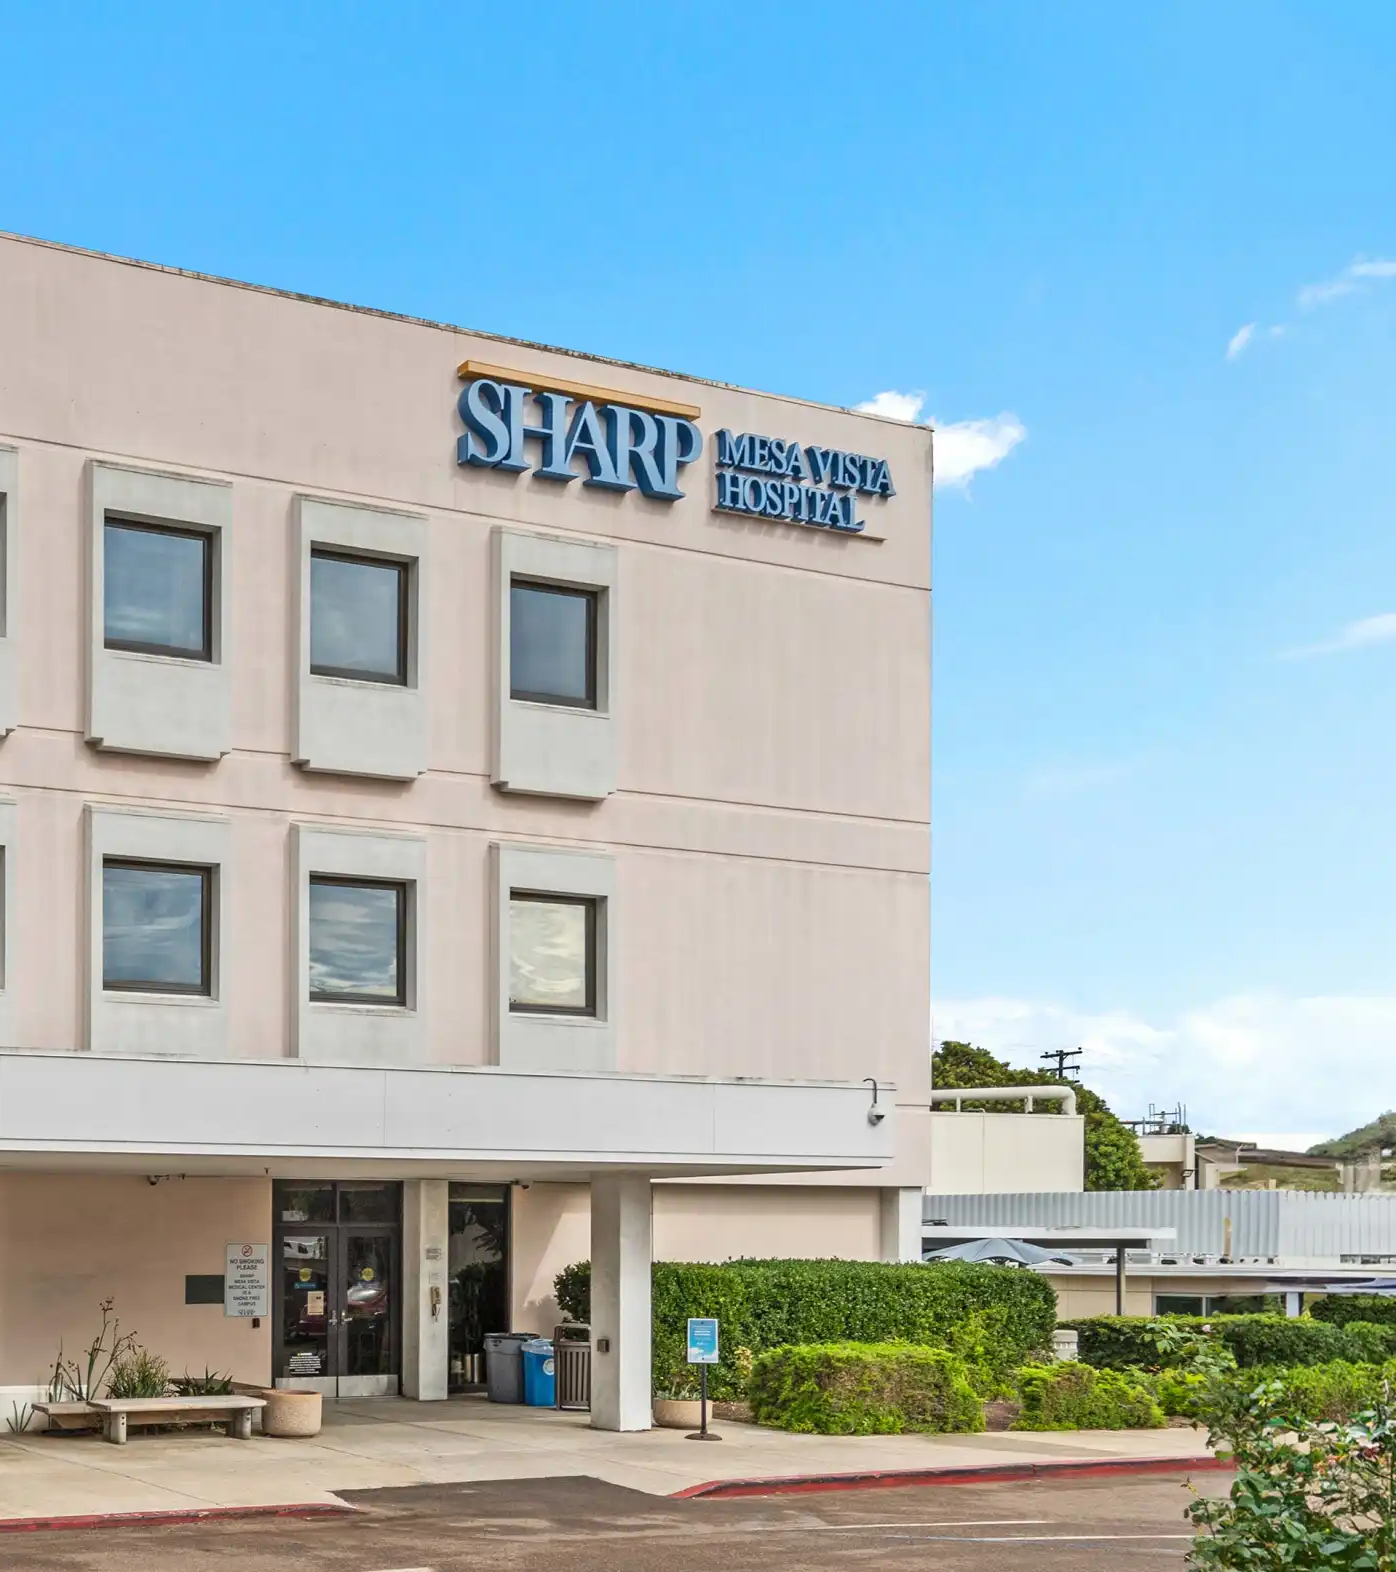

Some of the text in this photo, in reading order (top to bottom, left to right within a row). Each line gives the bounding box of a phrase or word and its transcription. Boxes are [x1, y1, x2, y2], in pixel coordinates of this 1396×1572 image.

[457, 378, 704, 502] SHARP
[714, 428, 897, 498] MESA VISTA
[716, 471, 866, 533] HOSPITAL
